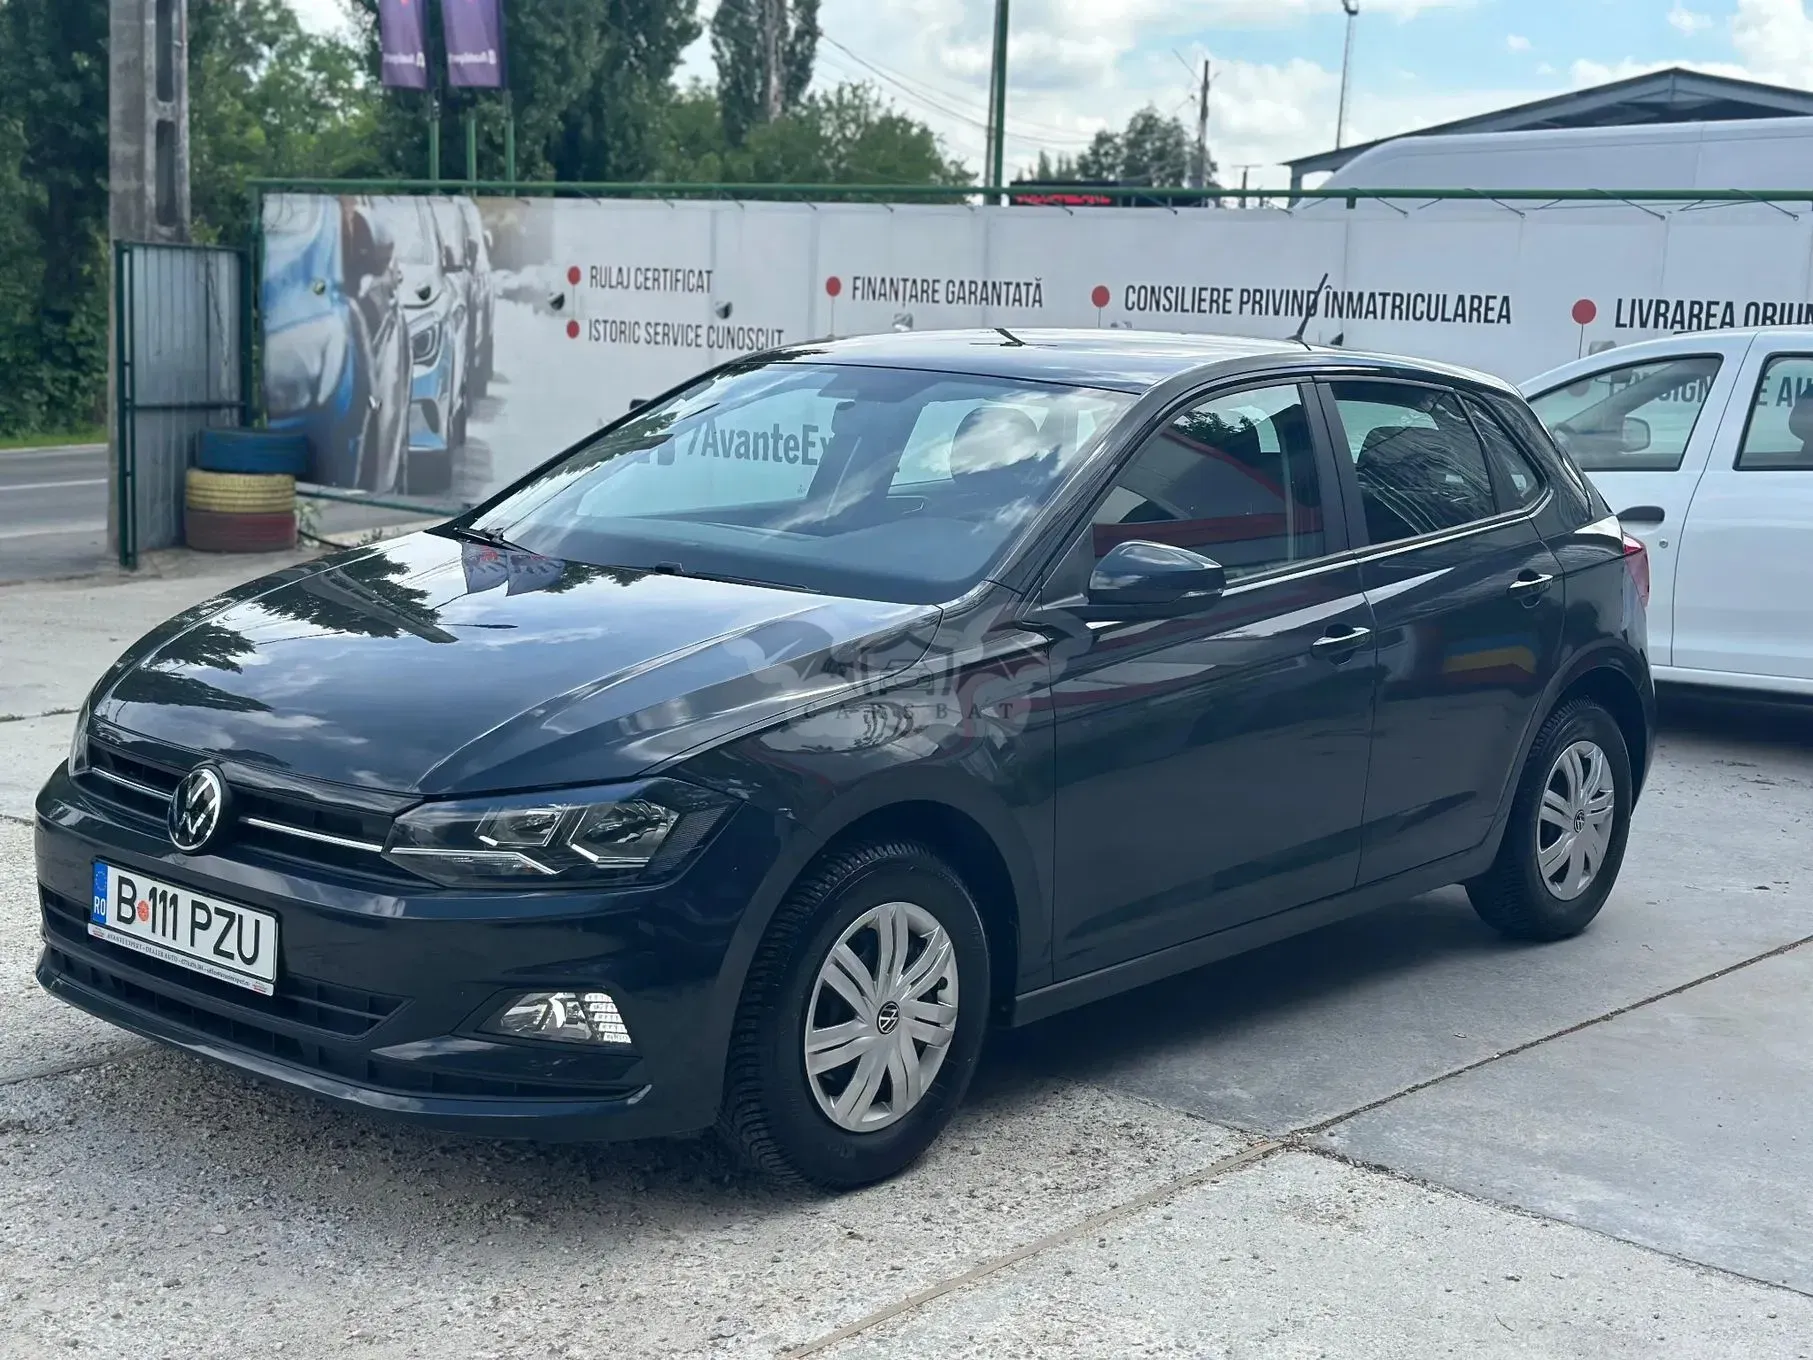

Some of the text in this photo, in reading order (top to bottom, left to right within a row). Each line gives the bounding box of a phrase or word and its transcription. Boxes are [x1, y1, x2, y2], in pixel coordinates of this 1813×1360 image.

[590, 265, 713, 293] RULAJ CERTIFICAT
[945, 277, 1043, 308] GARANTATĂ
[1124, 284, 1512, 325] CONSILIERE PRIVIND ÎNMATRICULAREA
[1615, 298, 1735, 331] LIVRAREA
[588, 318, 784, 350] ISTORIC SERVICE CUNOSCUT
[93, 896, 106, 916] RO
[116, 875, 260, 966] B 111 PZU
